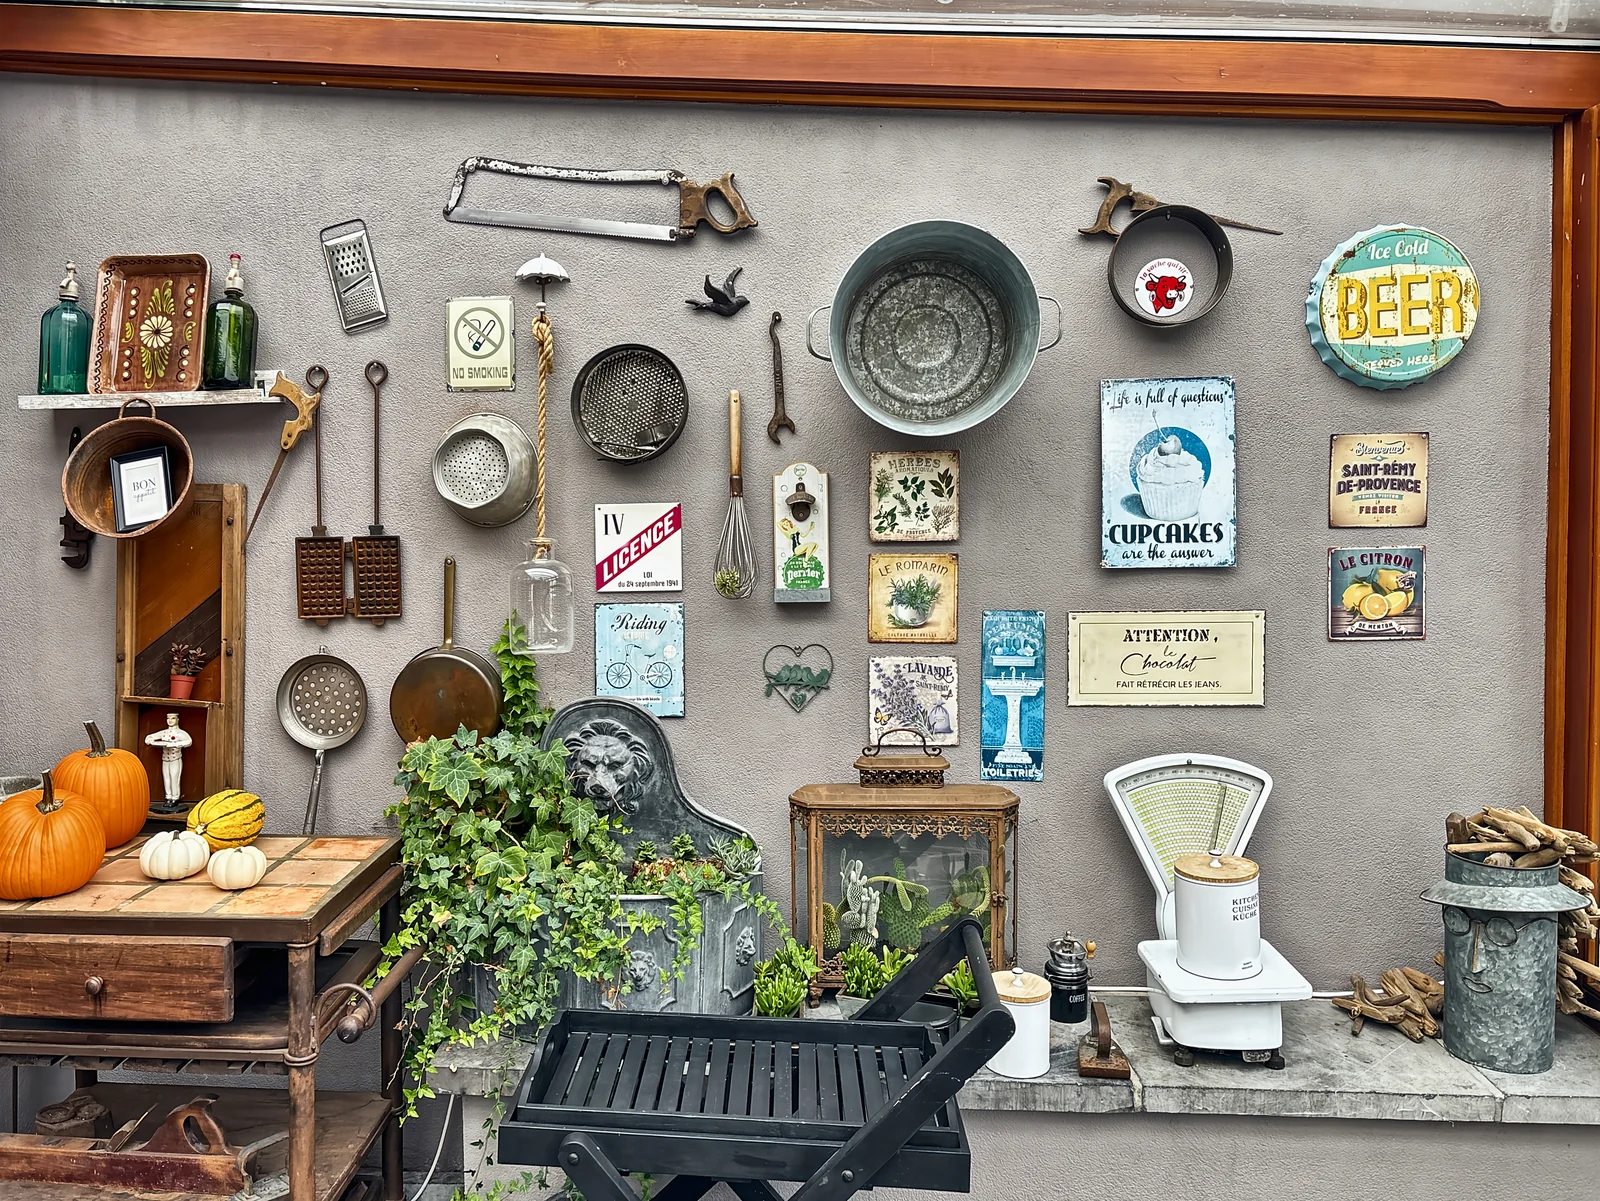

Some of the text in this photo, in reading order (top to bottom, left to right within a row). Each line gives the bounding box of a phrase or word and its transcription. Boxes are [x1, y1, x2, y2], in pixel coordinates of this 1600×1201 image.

[1367, 239, 1429, 260] Ice Cold
[1147, 261, 1166, 273] vache
[1167, 261, 1179, 269] qui
[1337, 272, 1465, 340] BEER
[1407, 354, 1437, 366] HERE
[452, 366, 508, 379] NO SMOKING
[1110, 386, 1224, 413] Life is full of questions
[888, 457, 941, 469] HERBES
[1342, 460, 1416, 478] SAINT-RÉMY
[132, 477, 156, 491] BON
[1336, 478, 1421, 496] DE-PROVENCE
[1359, 505, 1397, 514] FRANCE
[604, 513, 624, 535] IV
[1109, 522, 1224, 544] CUPCAKES
[603, 511, 675, 582] LICENCE
[1122, 542, 1214, 560] are the answer
[879, 560, 949, 576] LE ROMARIN
[1339, 552, 1413, 571] LE CITRON
[635, 580, 665, 588] septembre
[611, 612, 668, 635] Riding
[1163, 645, 1177, 657] le
[902, 662, 954, 683] LAVANDE
[1120, 653, 1217, 676] Chocolat
[1116, 679, 1222, 689] FAIT RÉTRÉCIR LES JEANS.
[983, 768, 1041, 777] TOILETRIES
[1233, 909, 1257, 921] KÜCHE
[1069, 994, 1085, 1003] COFFEE
